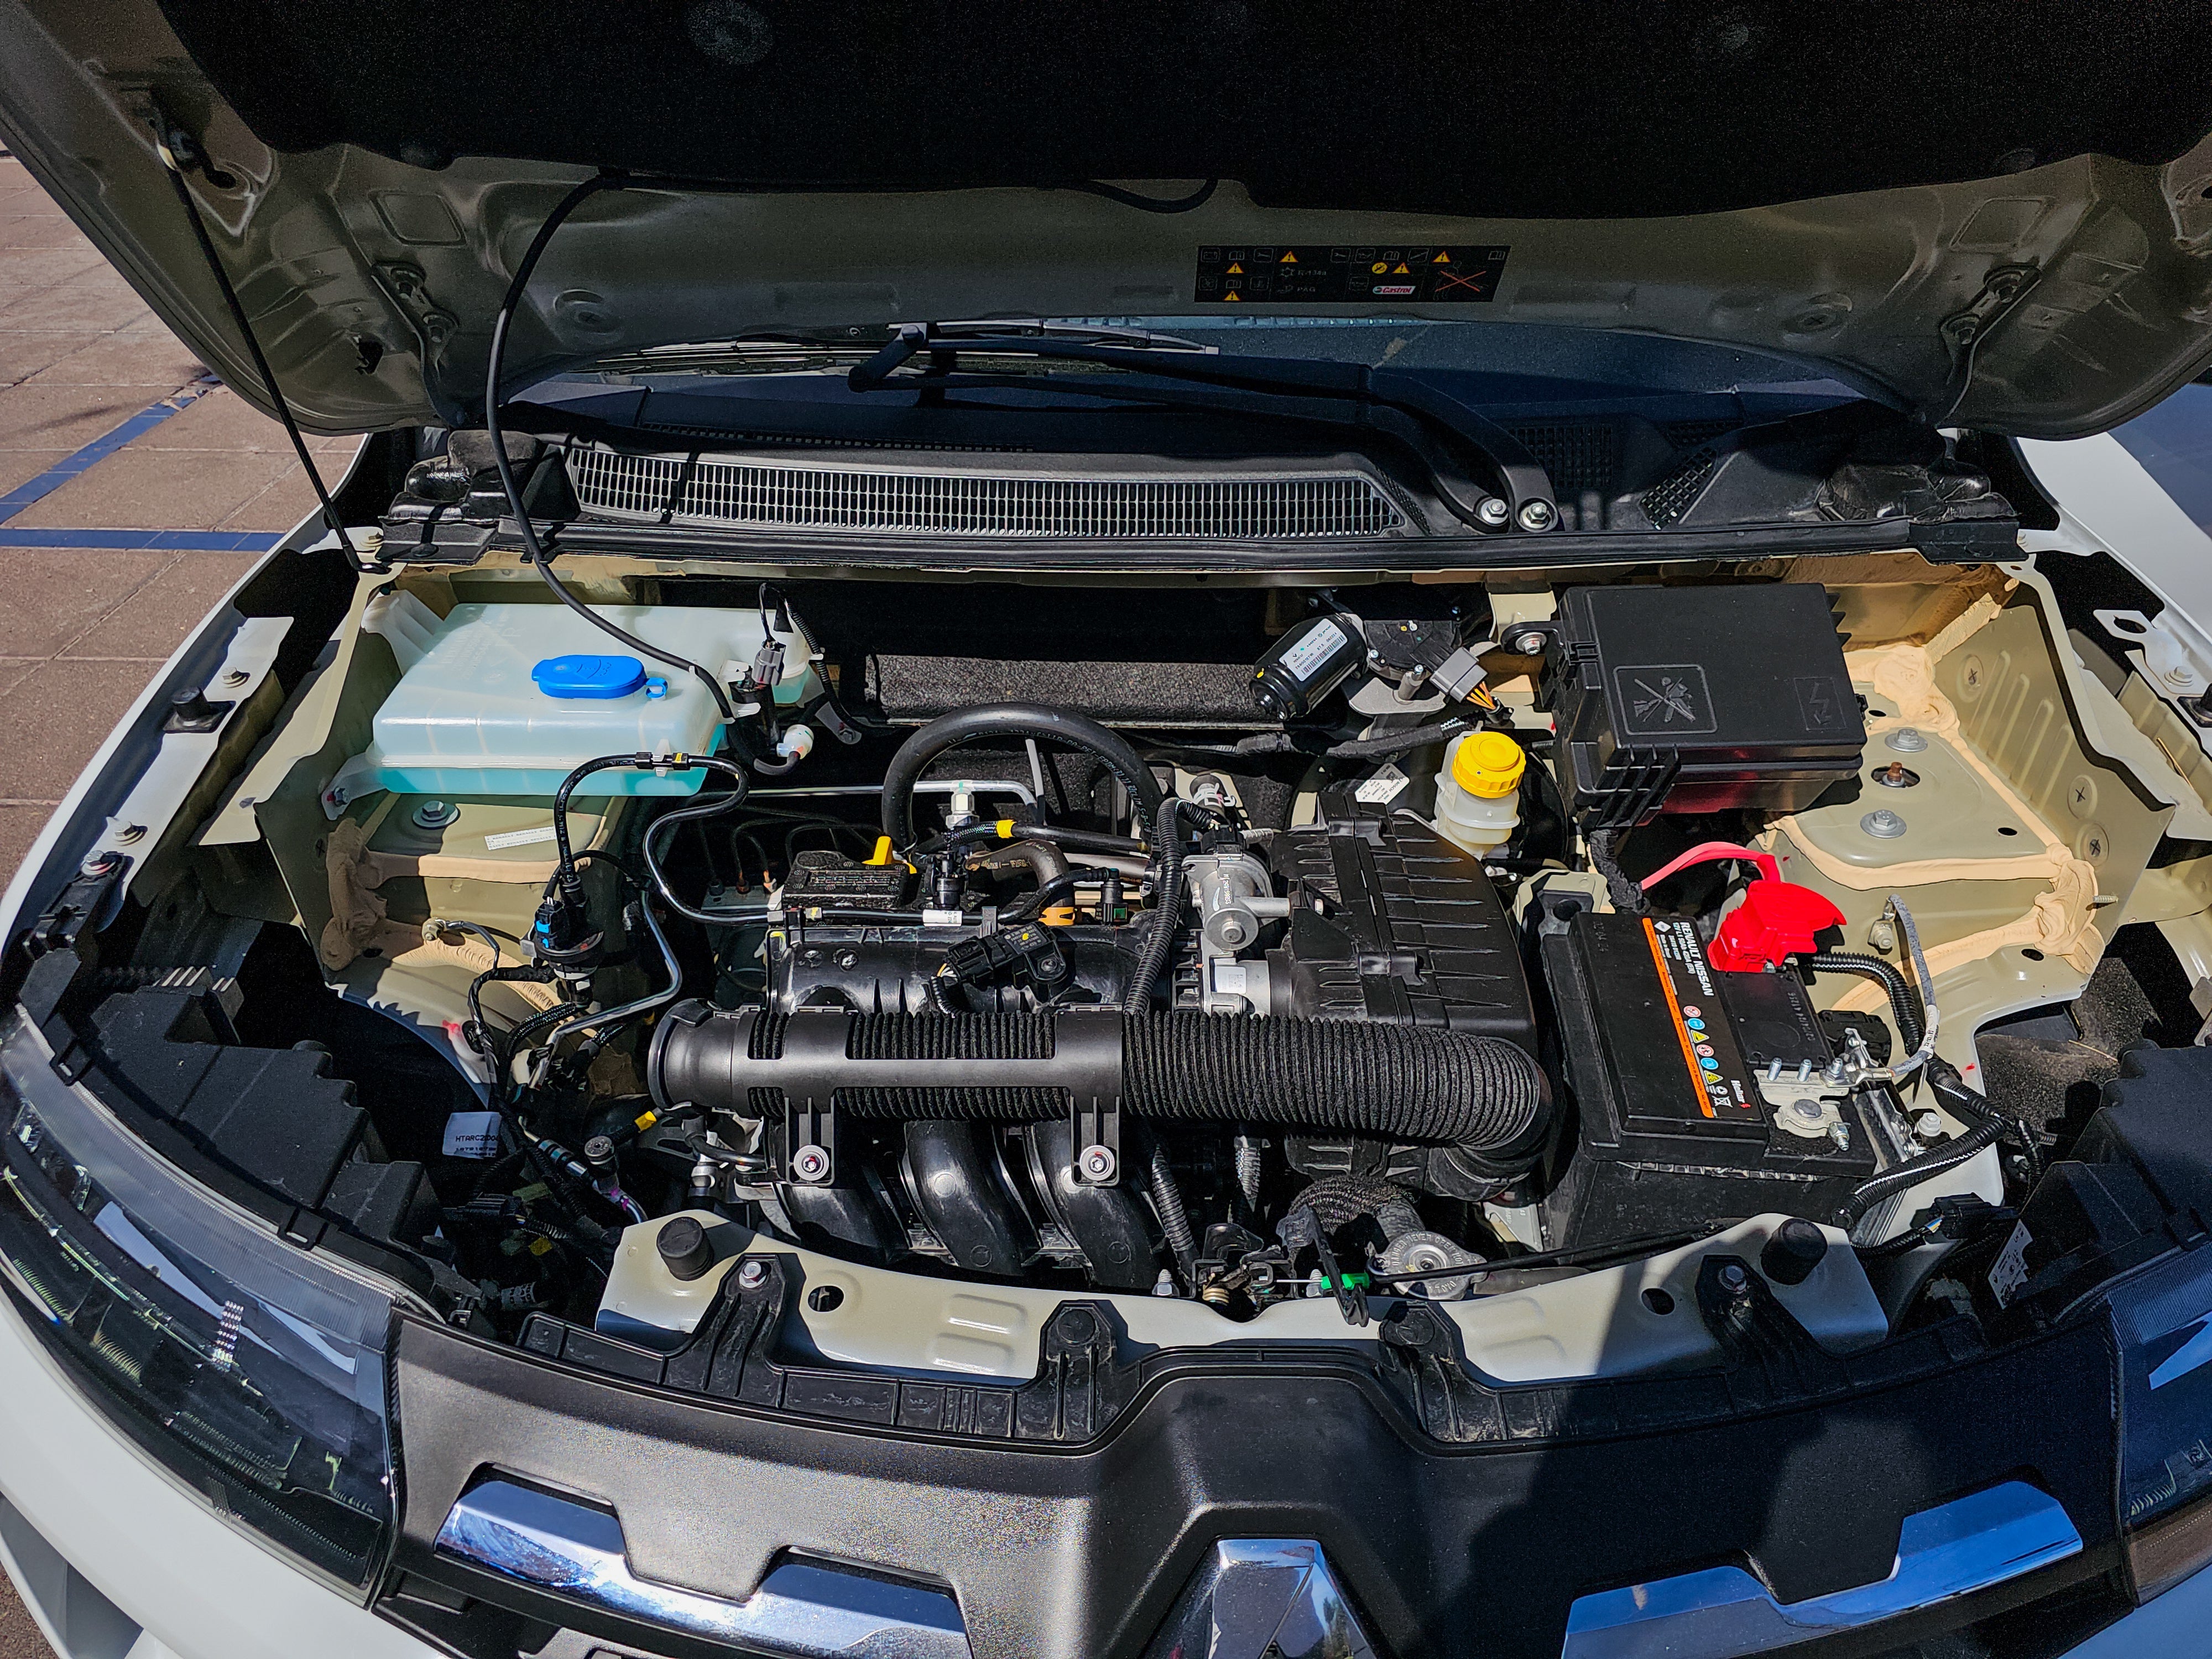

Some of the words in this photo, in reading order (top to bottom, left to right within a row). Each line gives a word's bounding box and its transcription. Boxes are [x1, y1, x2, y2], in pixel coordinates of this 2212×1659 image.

[1388, 780, 1400, 792] BOSCH
[1679, 922, 1702, 958] RENAULT
[1692, 960, 1714, 996] NISSAN
[1730, 1079, 1746, 1103] Heliar
[1406, 1233, 1432, 1243] NEVER
[1434, 1236, 1456, 1251] OPEN
[1452, 1252, 1464, 1265] HOT
